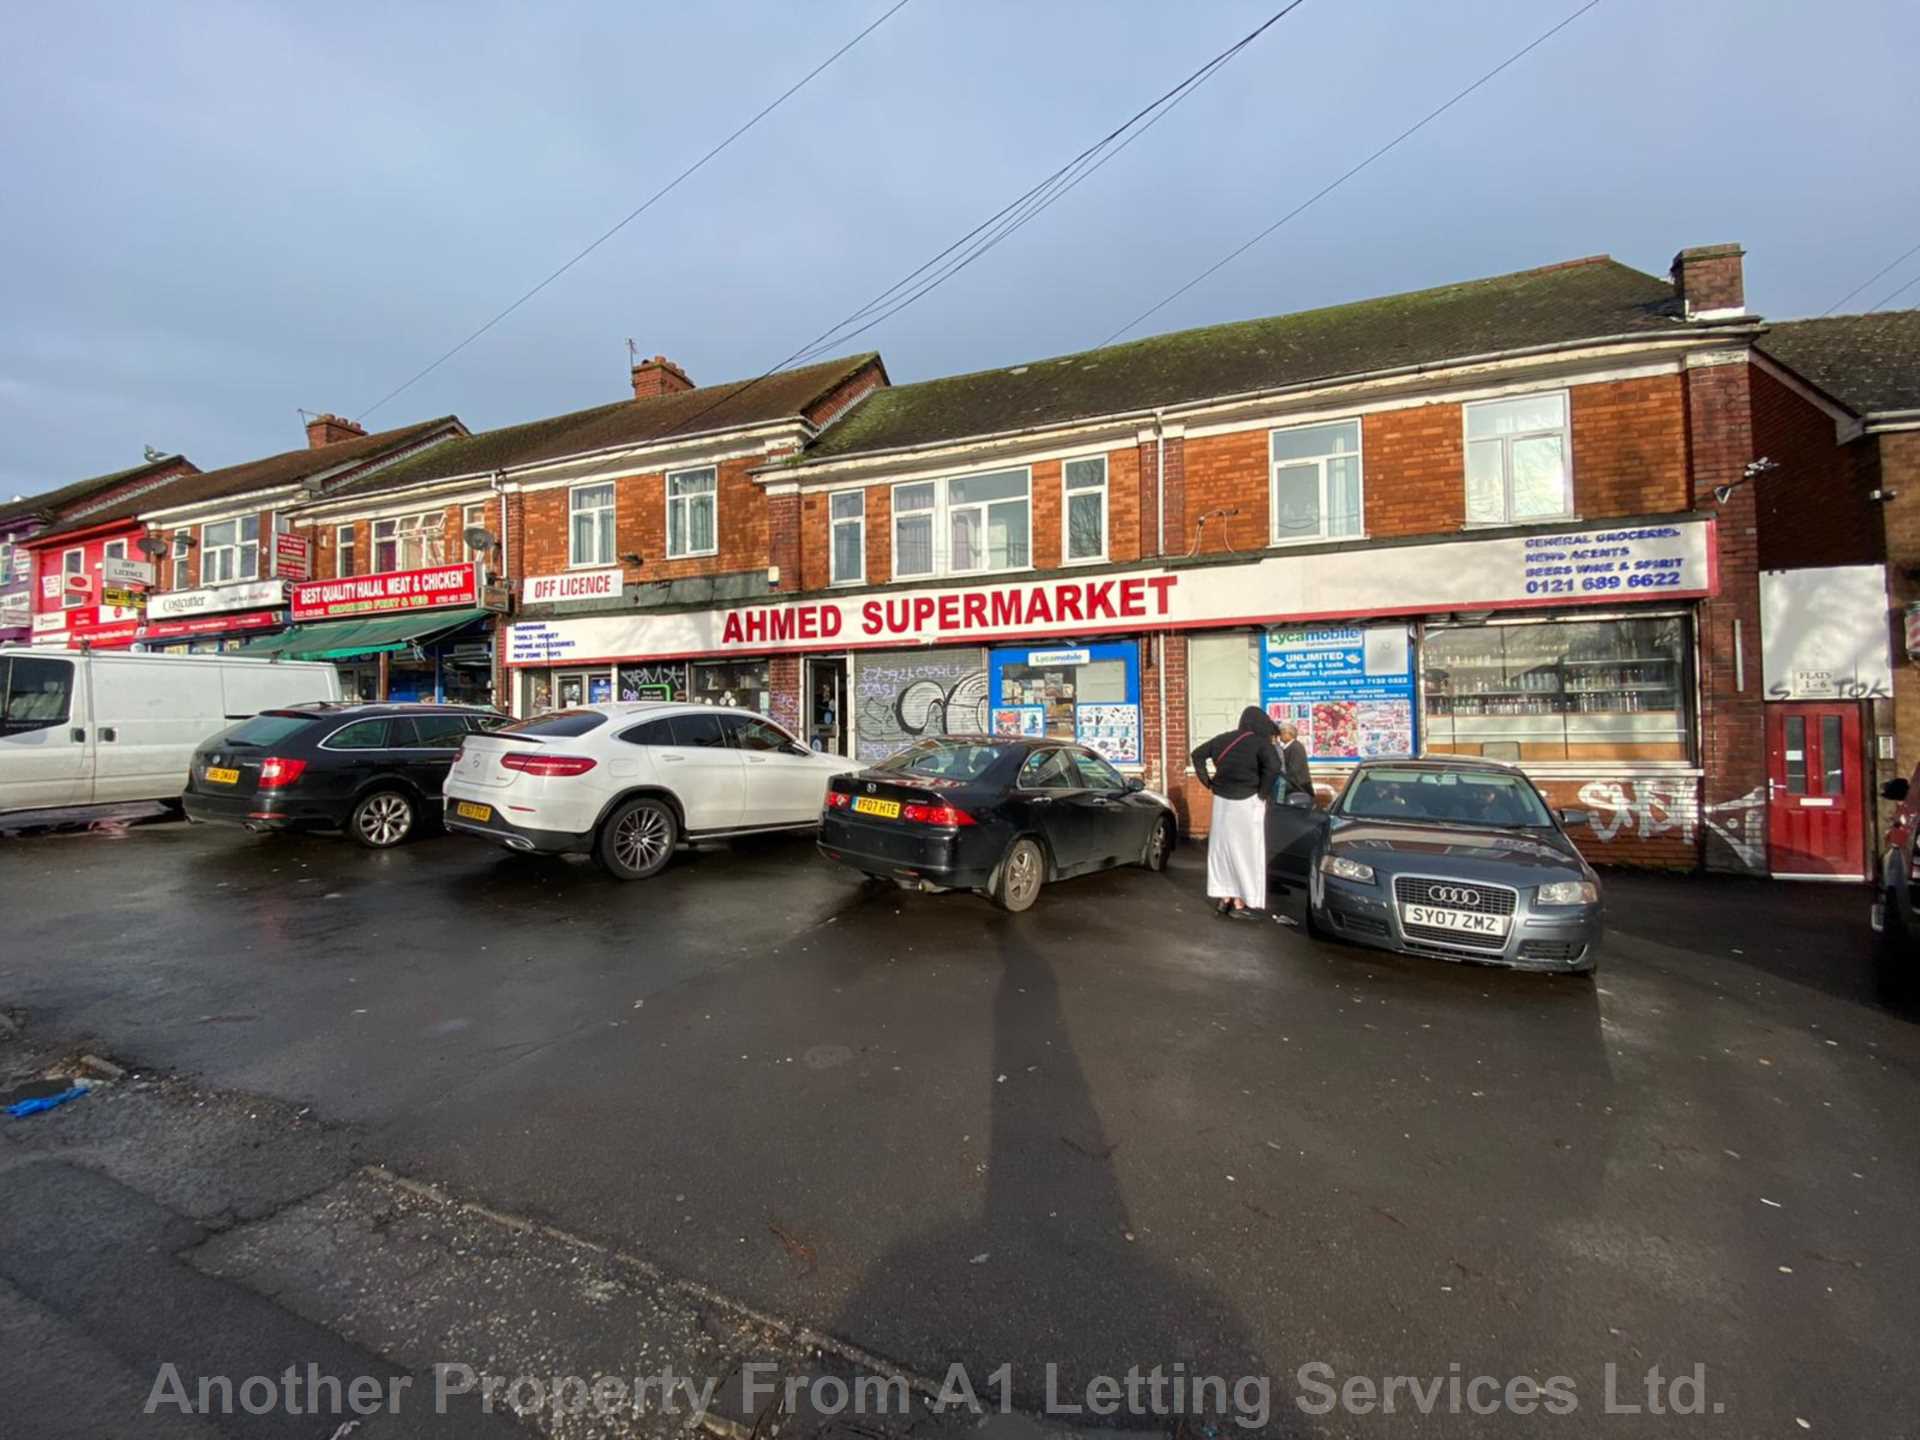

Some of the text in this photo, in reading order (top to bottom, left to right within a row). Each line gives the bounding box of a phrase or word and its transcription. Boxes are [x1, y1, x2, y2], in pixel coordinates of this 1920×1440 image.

[1524, 535, 1591, 549] GENERAL
[1569, 547, 1630, 560] AGENTS
[1525, 558, 1684, 577] BEERS WINE & SPIRIT
[300, 570, 464, 605] BEST QUALITY HALAL MEAT & CHICKEN
[534, 574, 611, 598] OFF LICENCE
[1525, 572, 1680, 594] 0121 689 6622
[722, 575, 1178, 643] AHMED SUPERMARKET
[1285, 652, 1344, 662] UNLIMITED
[1800, 671, 1832, 680] FLATS
[879, 802, 898, 815] HTE
[1413, 907, 1497, 932] SY07 ZMZ
